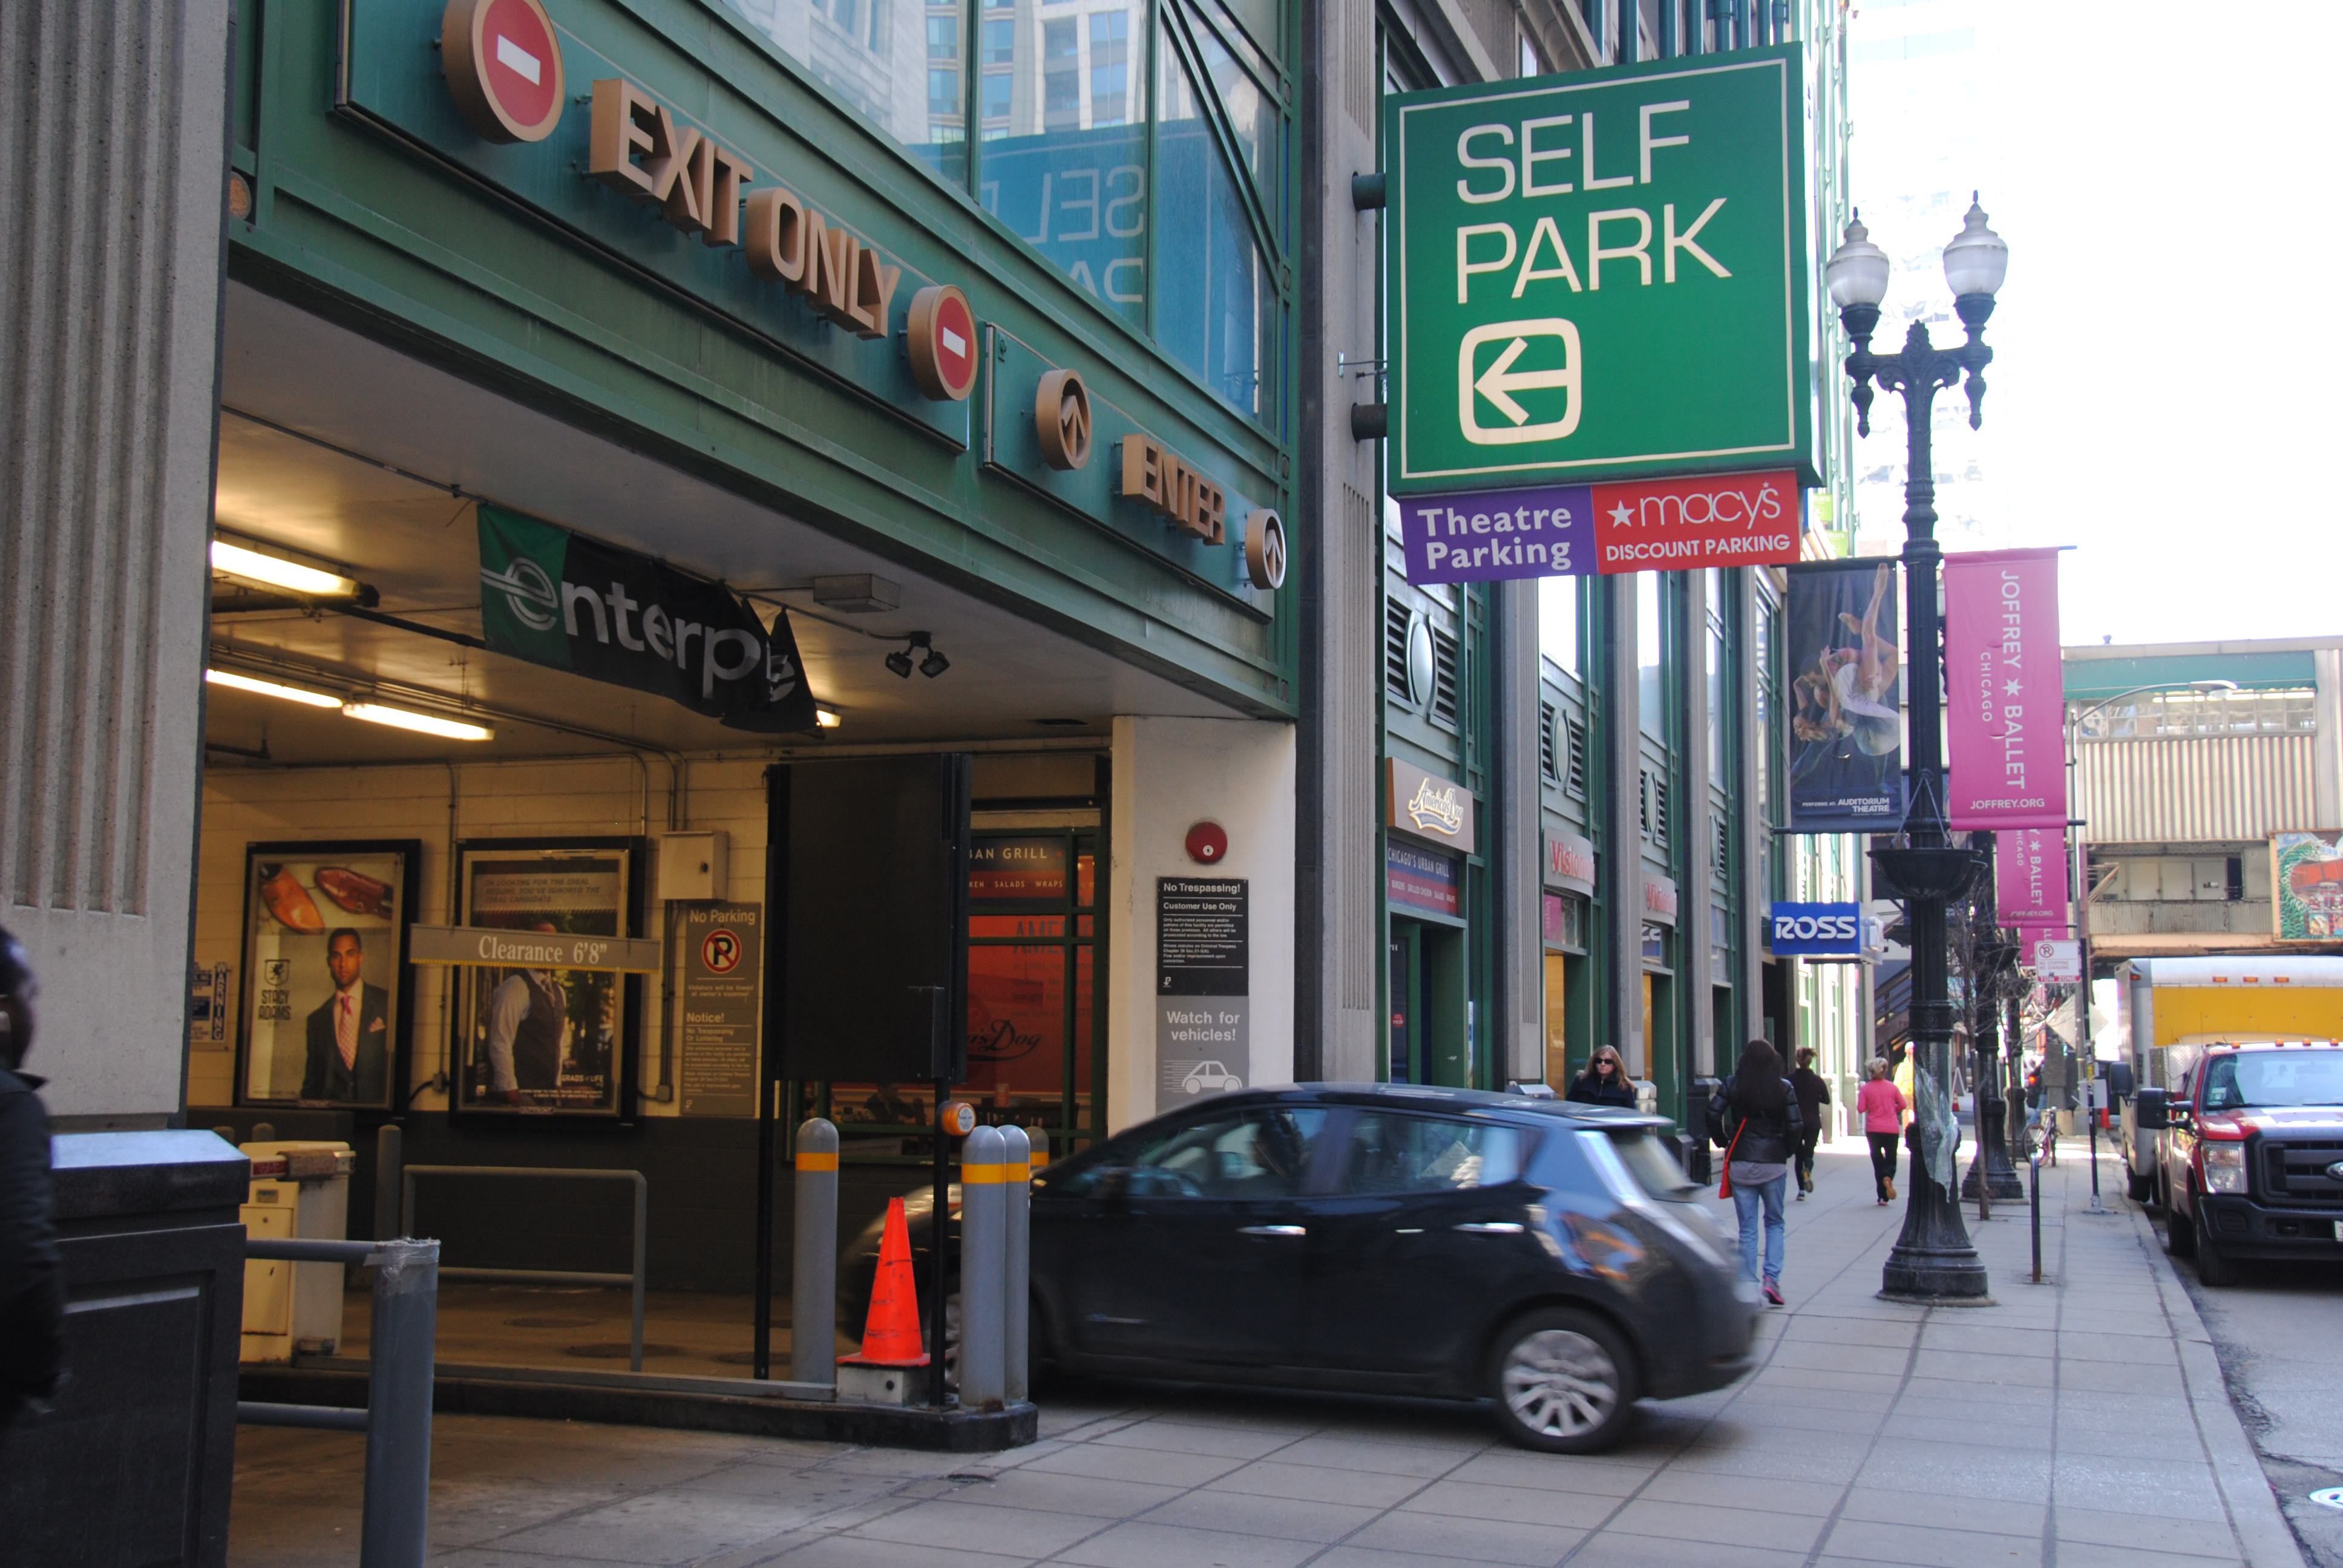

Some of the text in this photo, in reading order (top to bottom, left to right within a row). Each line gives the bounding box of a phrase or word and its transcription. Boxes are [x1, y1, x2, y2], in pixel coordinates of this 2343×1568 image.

[1457, 99, 1690, 204] SELF
[590, 77, 902, 341] EXIT ONLY
[1457, 197, 1732, 304] PARK
[1123, 433, 1225, 546] ENTER
[1417, 507, 1573, 538] Theatre
[1426, 536, 1572, 572] Parking
[1606, 534, 1791, 561] DISCOUNT PARKING
[1980, 652, 1993, 722] CHICAGO
[2001, 569, 2025, 789] JOFFREY BALLET
[1837, 797, 1890, 806] AUDITORIUM
[1970, 798, 2045, 810] JOFFREY.ORG
[1003, 847, 1047, 860] GRILL
[2016, 830, 2024, 866] HICAGO
[1388, 847, 1449, 878] CHICAGO'S URBAN GRILL
[1163, 883, 1240, 895] No Trespassing!
[2030, 856, 2042, 906] BALLET
[689, 909, 756, 926] No Parking
[1163, 901, 1201, 910] Customer
[1219, 902, 1237, 912] Only
[1775, 915, 1856, 939] ROSS
[479, 935, 563, 963] Clearance
[214, 962, 227, 1039] WARNING
[261, 989, 290, 1004] STACY
[258, 1005, 291, 1021] ADAMS
[686, 1012, 725, 1023] Notice!
[1167, 1010, 1240, 1025] Watch for
[1170, 1028, 1236, 1041] vehicles!
